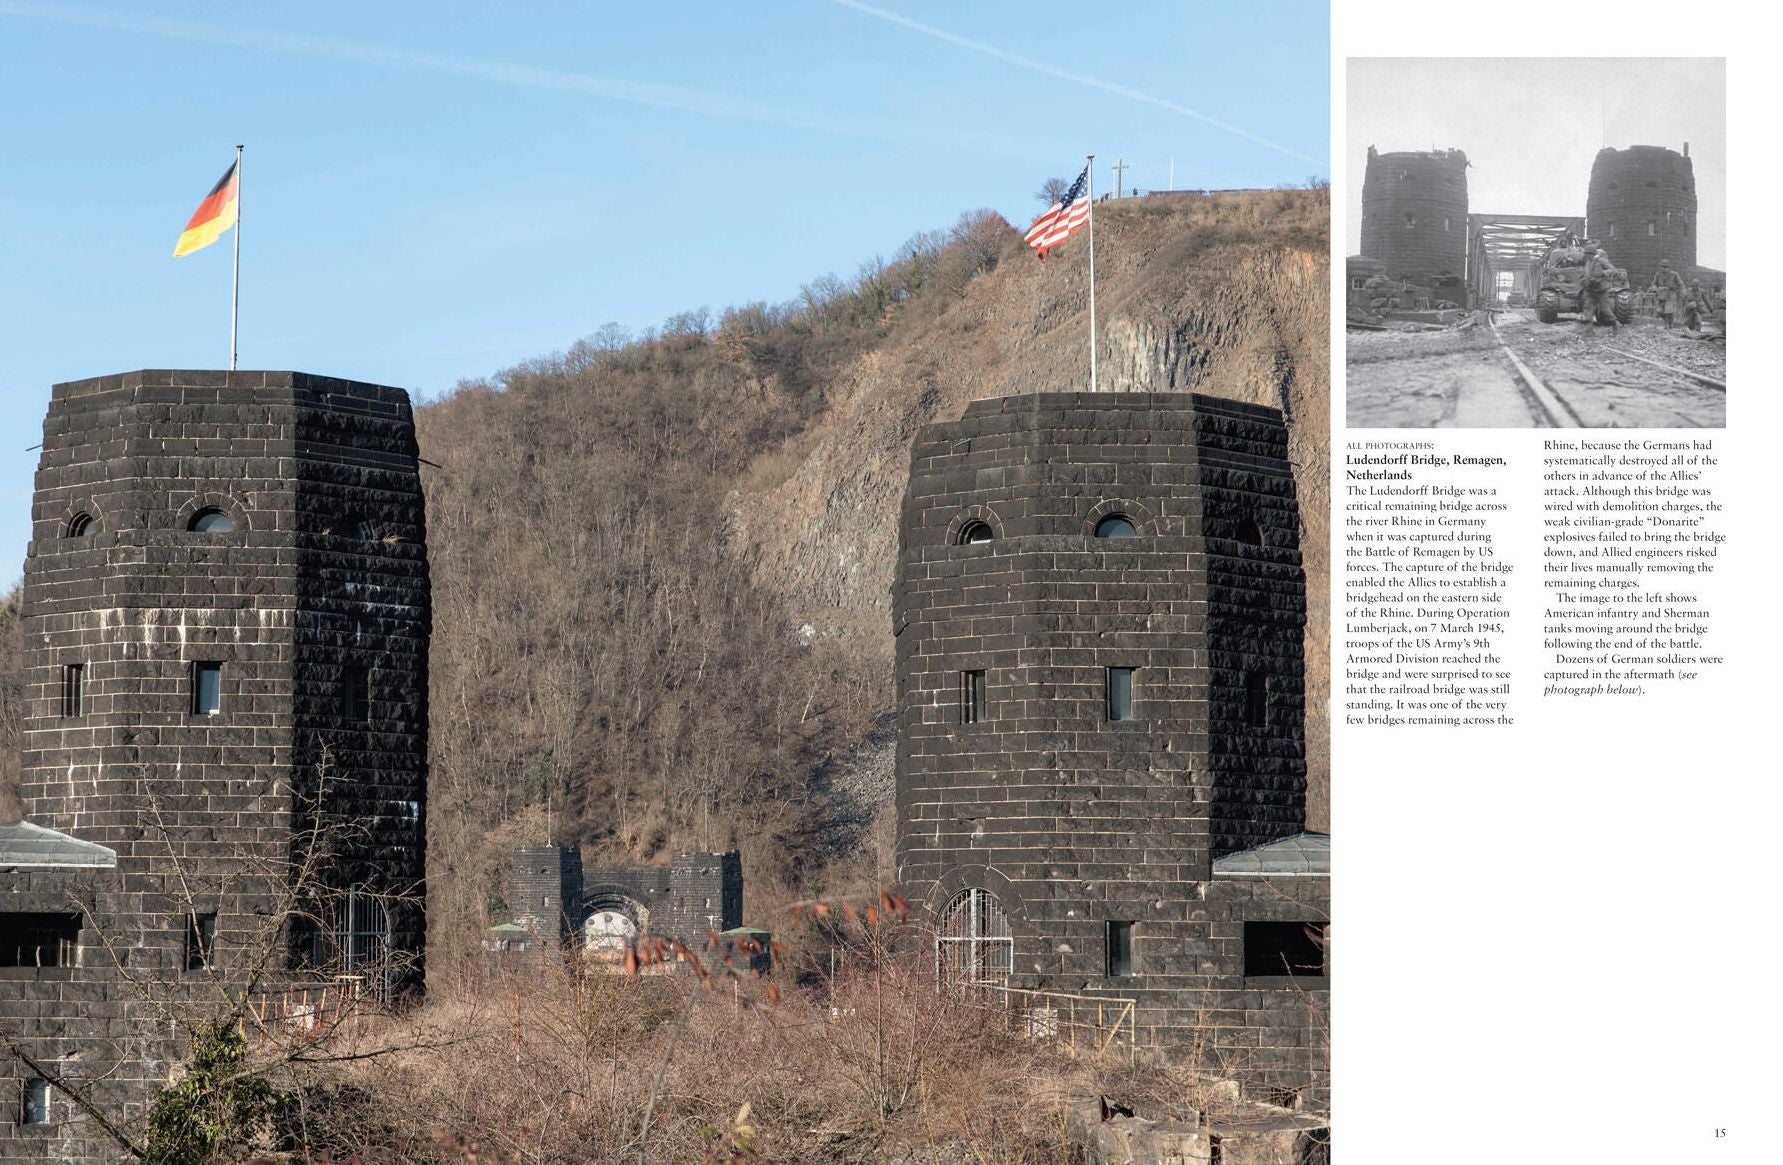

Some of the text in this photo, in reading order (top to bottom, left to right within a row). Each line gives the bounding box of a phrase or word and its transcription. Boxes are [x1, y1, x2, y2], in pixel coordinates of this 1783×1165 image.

[1544, 439, 1712, 451] Rhine, because the Germans had
[1346, 455, 1507, 468] Ludendorff Bridge, Remagen,
[1543, 455, 1718, 468] systematically destroyed all of the
[1346, 470, 1412, 480] Netherlands
[1543, 470, 1576, 480] others
[1579, 471, 1589, 480] in
[1592, 470, 1633, 480] advance
[1635, 470, 1647, 480] of
[1650, 470, 1667, 480] the
[1346, 485, 1367, 495] The
[1370, 485, 1429, 495] Ludendorff
[1432, 485, 1466, 498] Bridge
[1544, 485, 1579, 495] attack.
[1582, 485, 1631, 498] Although
[1634, 485, 1653, 495] this
[1656, 485, 1689, 498] bridge
[1346, 500, 1382, 510] critical
[1385, 501, 1437, 513] remaining
[1439, 500, 1473, 513] bridge
[1544, 500, 1722, 513] wired with demolition charges, the
[1346, 516, 1486, 529] the river Rhine in Germany
[1544, 516, 1571, 526] weak
[1573, 516, 1644, 529] civilian-grade
[1346, 531, 1373, 541] when
[1376, 532, 1384, 541] it
[1409, 531, 1454, 544] captured
[1457, 531, 1492, 544] during
[1543, 531, 1726, 544] explosives failed to bring the bridge
[1543, 546, 1717, 559] down, and Allied engineers risked
[1346, 561, 1514, 574] forces. The capture of the bridge
[1544, 561, 1714, 574] their lives manually removing the
[1345, 577, 1386, 587] enabled
[1388, 577, 1405, 587] the
[1408, 577, 1437, 587] Allies
[1439, 578, 1451, 587] to
[1453, 577, 1497, 587] establish
[1544, 577, 1640, 590] remaining charges.
[1346, 592, 1404, 605] bridgehead
[1423, 592, 1439, 602] the
[1441, 593, 1479, 602] eastern
[1481, 592, 1502, 602] side
[1556, 592, 1697, 605] The image to the left shows
[1346, 607, 1510, 620] of the Rhine. During Operation
[1544, 607, 1710, 620] American infantry and Sherman
[1346, 623, 1412, 636] Lumberjack,
[1430, 623, 1437, 633] 7
[1440, 623, 1474, 633] March
[1478, 623, 1504, 635] 1945,
[1544, 623, 1708, 636] tanks moving around the bridge
[1346, 639, 1380, 651] troops
[1382, 638, 1394, 648] of
[1397, 638, 1413, 648] the
[1416, 638, 1431, 648] US
[1473, 638, 1490, 648] 9th
[1556, 653, 1594, 663] Dozens
[1596, 653, 1608, 663] of
[1611, 653, 1654, 663] German
[1656, 653, 1696, 663] soldiers
[1346, 668, 1379, 681] bridge
[1382, 668, 1401, 678] and
[1431, 668, 1479, 681] surprised
[1481, 669, 1493, 678] to
[1543, 668, 1698, 681] captured in the aftermath (see
[1346, 684, 1367, 694] that
[1370, 684, 1386, 694] the
[1389, 684, 1430, 694] railroad
[1433, 684, 1466, 697] bridge
[1491, 684, 1510, 694] still
[1543, 684, 1645, 697] photograph below).
[1346, 714, 1364, 724] few
[1368, 714, 1406, 727] bridges
[1408, 715, 1461, 727] remaining
[1497, 714, 1514, 724] the
[1715, 1128, 1726, 1138] 15
